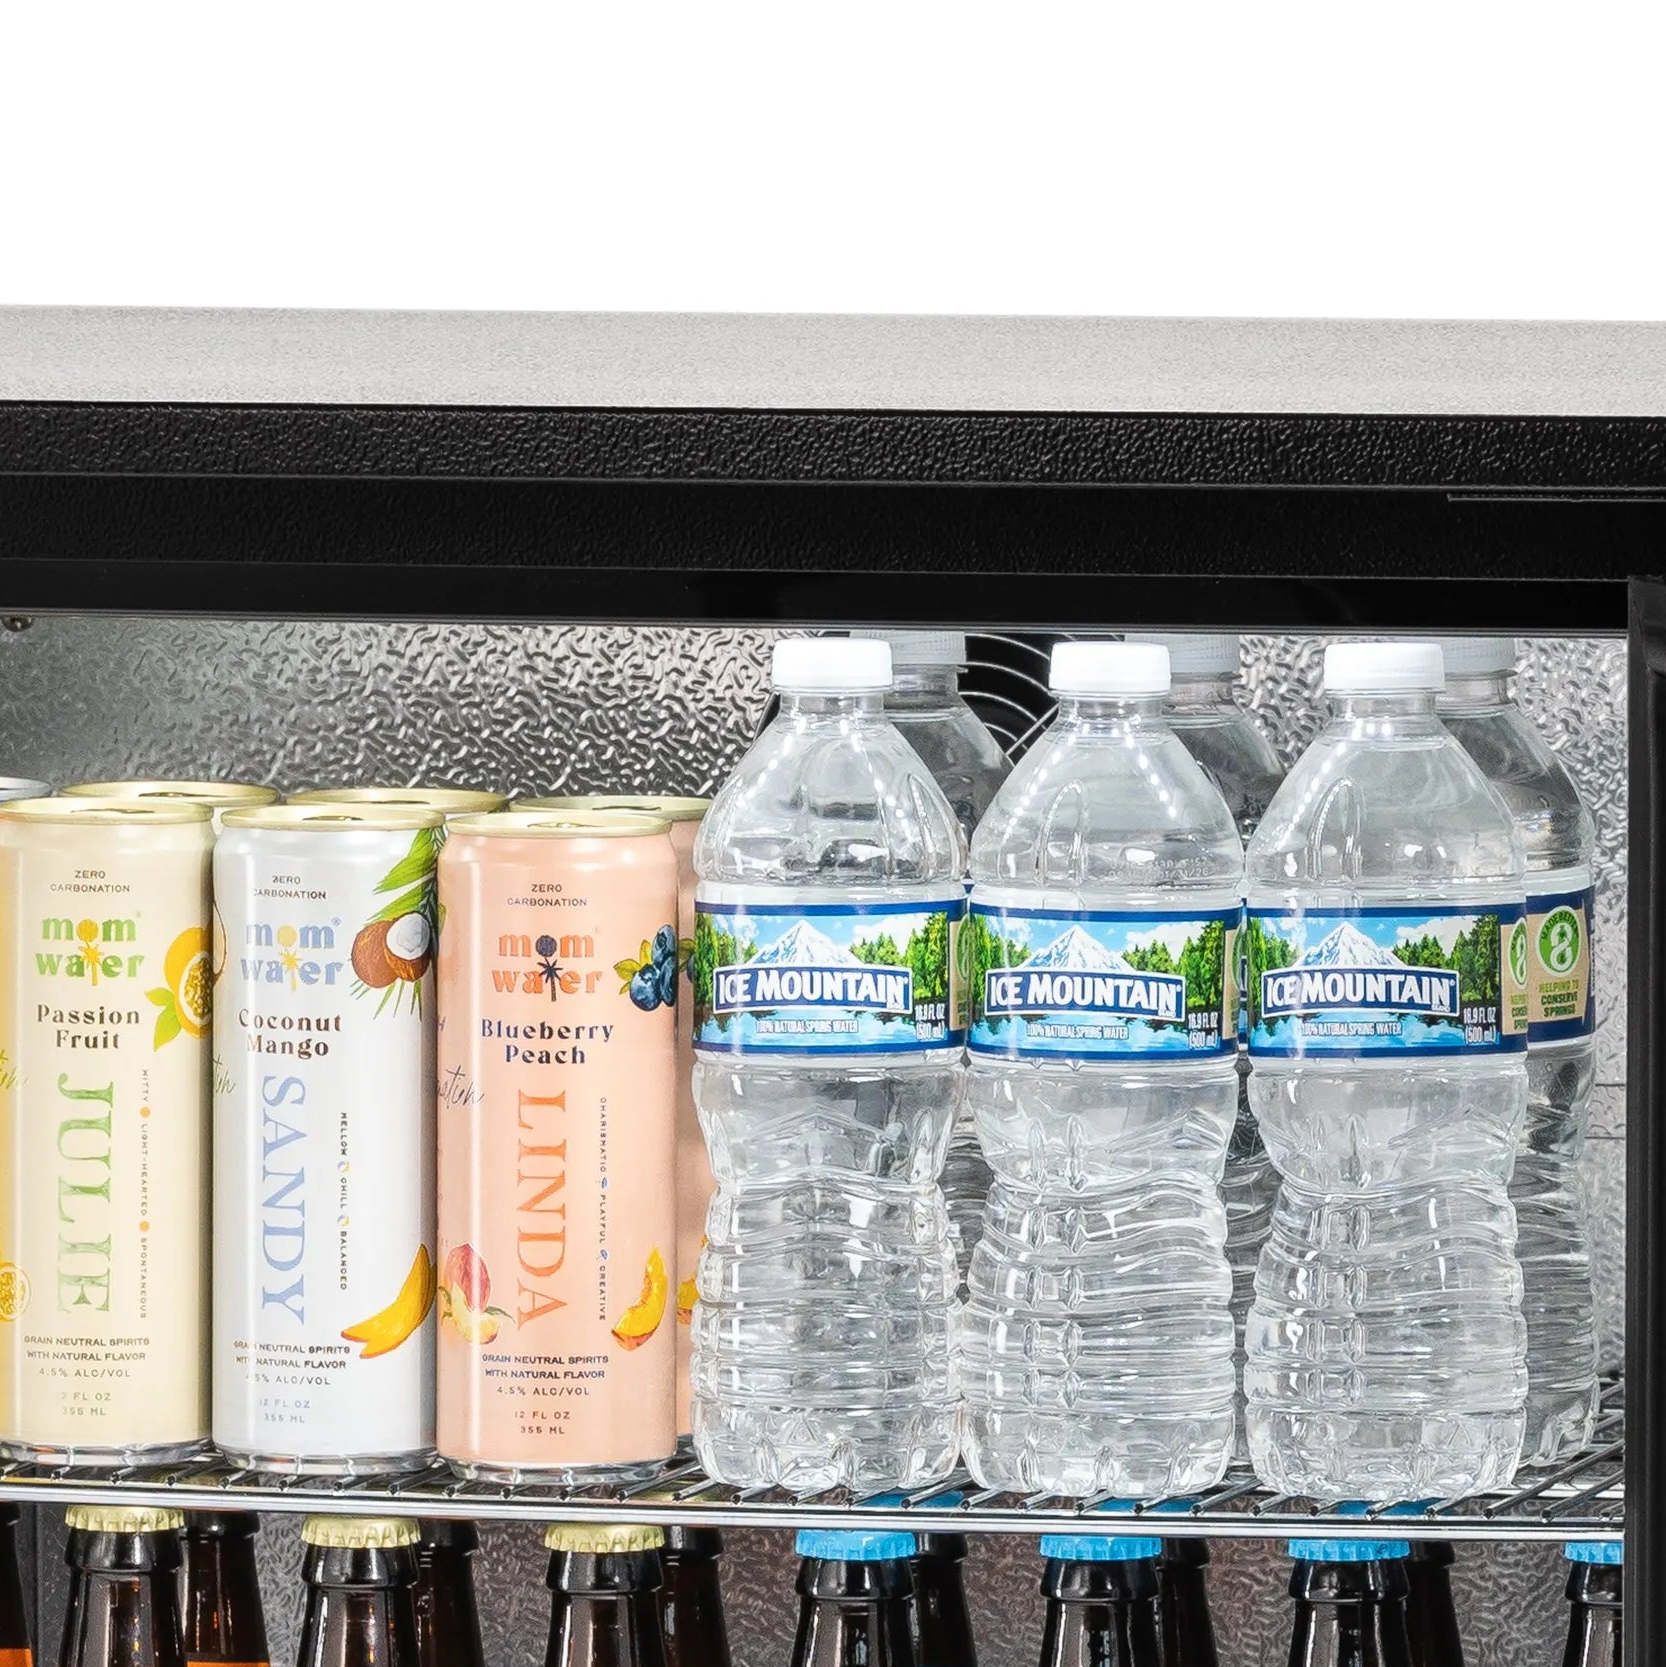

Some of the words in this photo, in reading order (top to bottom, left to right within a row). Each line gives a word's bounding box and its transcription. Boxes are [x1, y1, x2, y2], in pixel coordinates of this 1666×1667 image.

[74, 870, 106, 879] ZERO
[272, 875, 301, 885] ZERO
[50, 883, 130, 893] CARBONATION
[531, 883, 563, 893] ZERO
[507, 897, 588, 907] CARBONATION
[719, 972, 751, 1004] ICE
[755, 970, 905, 1006] MOUNTAIN
[990, 975, 1023, 1006] ICE
[1027, 973, 1178, 1012] MOUNTAIN
[1265, 975, 1296, 1008] ICE
[1301, 972, 1451, 1006] MOUNTAIN
[1540, 990, 1579, 1005] CONSERVE
[37, 1003, 140, 1025] Passion
[1479, 1008, 1487, 1023] FL
[1488, 1008, 1497, 1023] OZ
[1543, 1003, 1576, 1018] SPRINGS
[238, 1008, 342, 1032] Coconut
[480, 1019, 614, 1043] Blueberry
[1348, 1022, 1375, 1036] SPRING
[1376, 1022, 1402, 1036] WATER
[55, 1029, 120, 1050] Fruit
[246, 1034, 329, 1060] Mango
[505, 1044, 586, 1064] Peach
[140, 1123, 148, 1216] LIGHT-HEARTED
[57, 1072, 114, 1314] JULIE
[261, 1074, 308, 1326] SANDY
[340, 1177, 348, 1209] CHILL
[517, 1088, 568, 1332] LINDA
[340, 1230, 348, 1291] BALANCED
[55, 1337, 106, 1347] NEUTRAL
[109, 1337, 150, 1347] SPIRITS
[258, 1343, 306, 1354] NEUTRAL
[52, 1352, 102, 1362] NATURAL
[104, 1352, 146, 1362] FLAVOR
[514, 1355, 565, 1365] NEUTRAL
[568, 1355, 609, 1365] SPIRITS
[304, 1360, 347, 1370] FLAVOR
[511, 1369, 561, 1380] NATURAL
[563, 1370, 606, 1380] FLAVOR
[497, 1385, 527, 1396] 4.5%
[532, 1386, 590, 1397] ALC/VOL
[532, 1410, 547, 1420] FL
[554, 1411, 571, 1420] OZ
